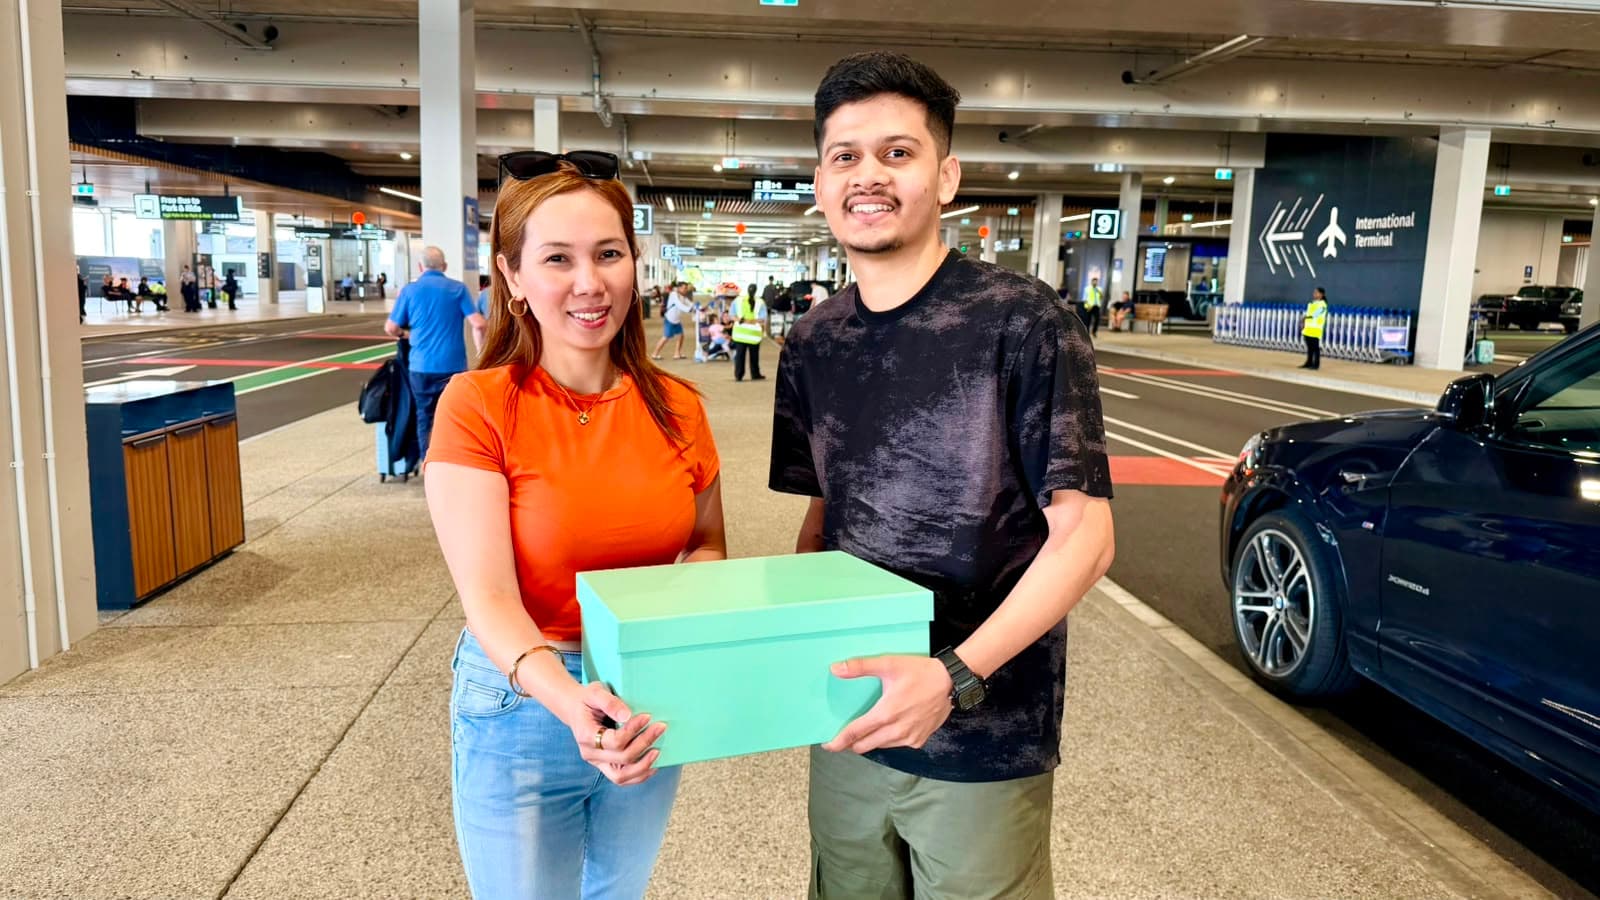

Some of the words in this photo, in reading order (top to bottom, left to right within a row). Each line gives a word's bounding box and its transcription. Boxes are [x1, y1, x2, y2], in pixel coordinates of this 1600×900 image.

[161, 196, 176, 204] Free
[177, 196, 191, 204] Bus
[191, 197, 200, 205] to
[161, 204, 177, 212] Park
[185, 204, 202, 212] Ride
[1097, 214, 1112, 233] 9
[1355, 211, 1415, 229] International
[1354, 231, 1394, 248] Terminal
[309, 247, 317, 255] C
